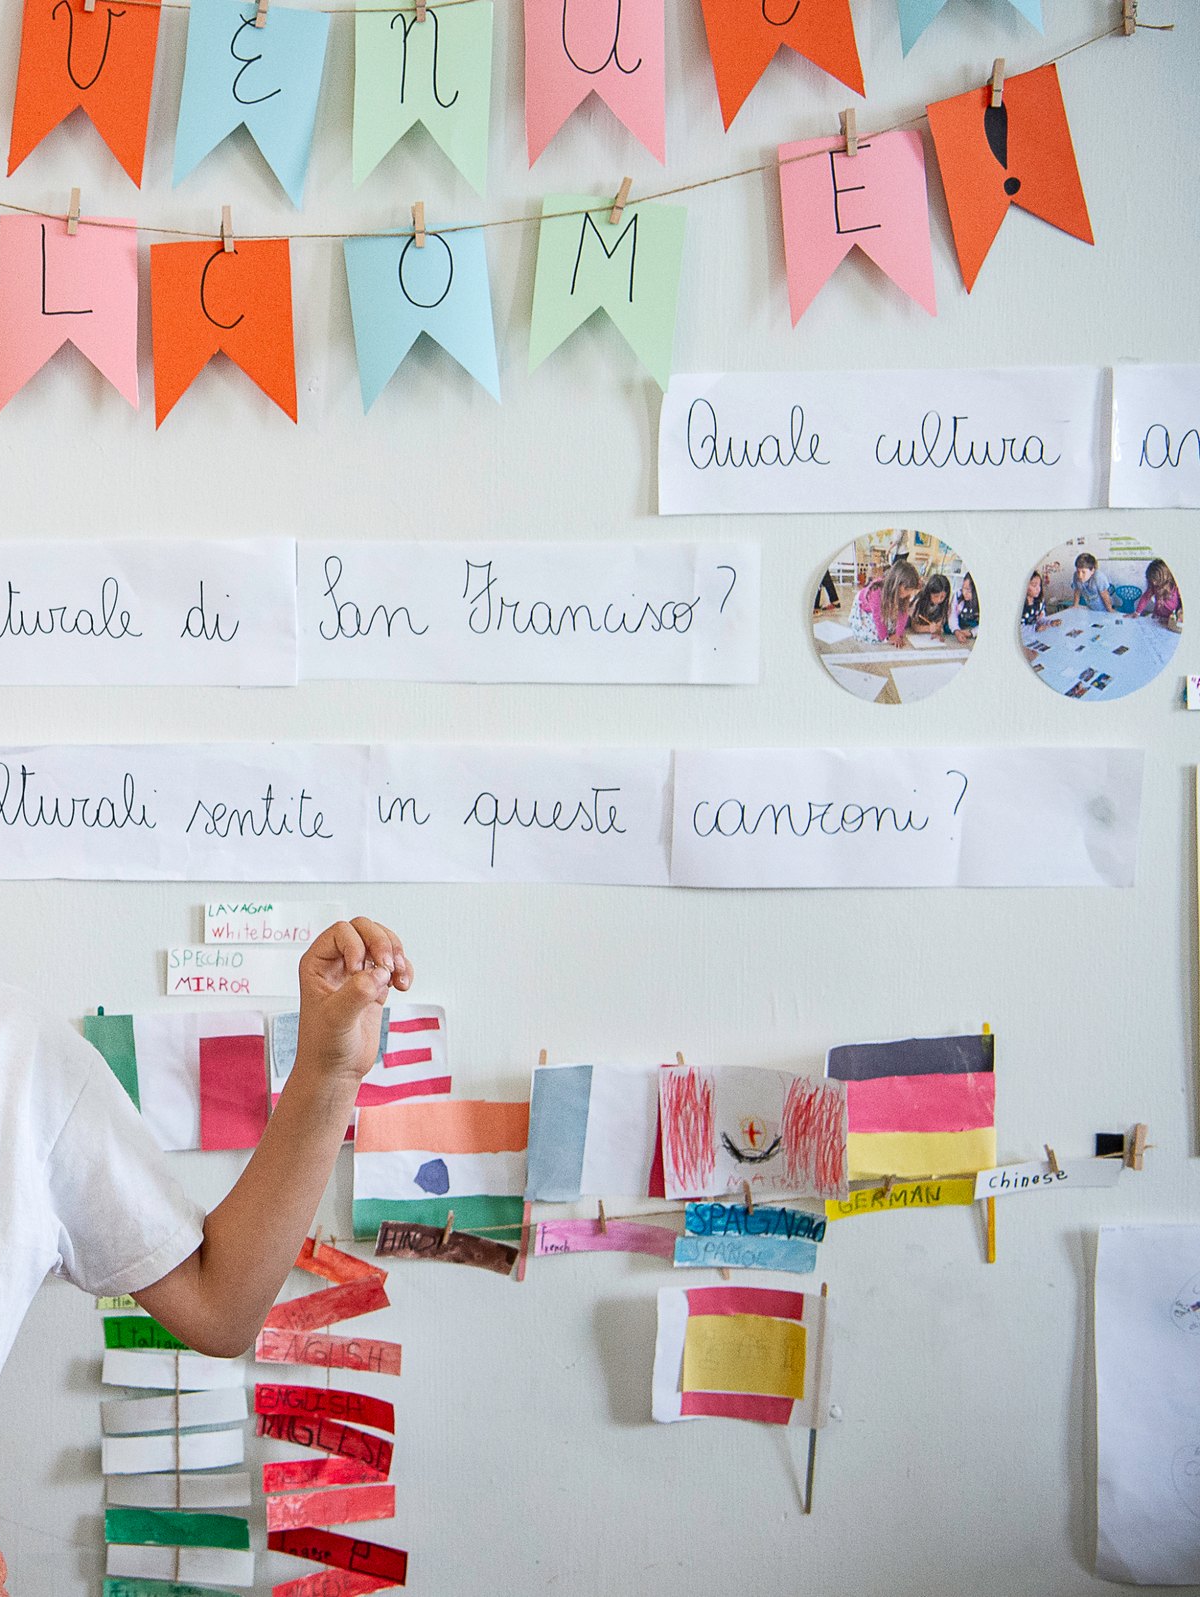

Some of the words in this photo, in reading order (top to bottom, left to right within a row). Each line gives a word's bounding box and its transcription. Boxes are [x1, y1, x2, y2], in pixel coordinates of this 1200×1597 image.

[687, 398, 831, 470] Quale
[875, 410, 1063, 468] cultura
[180, 580, 239, 642] di
[319, 556, 429, 640] San
[186, 784, 333, 839] sentite
[378, 782, 430, 826] in
[464, 788, 627, 868] queste
[208, 902, 273, 917] LAVAGNA
[174, 976, 250, 994] MIRROR
[837, 1184, 942, 1214] GERMAN
